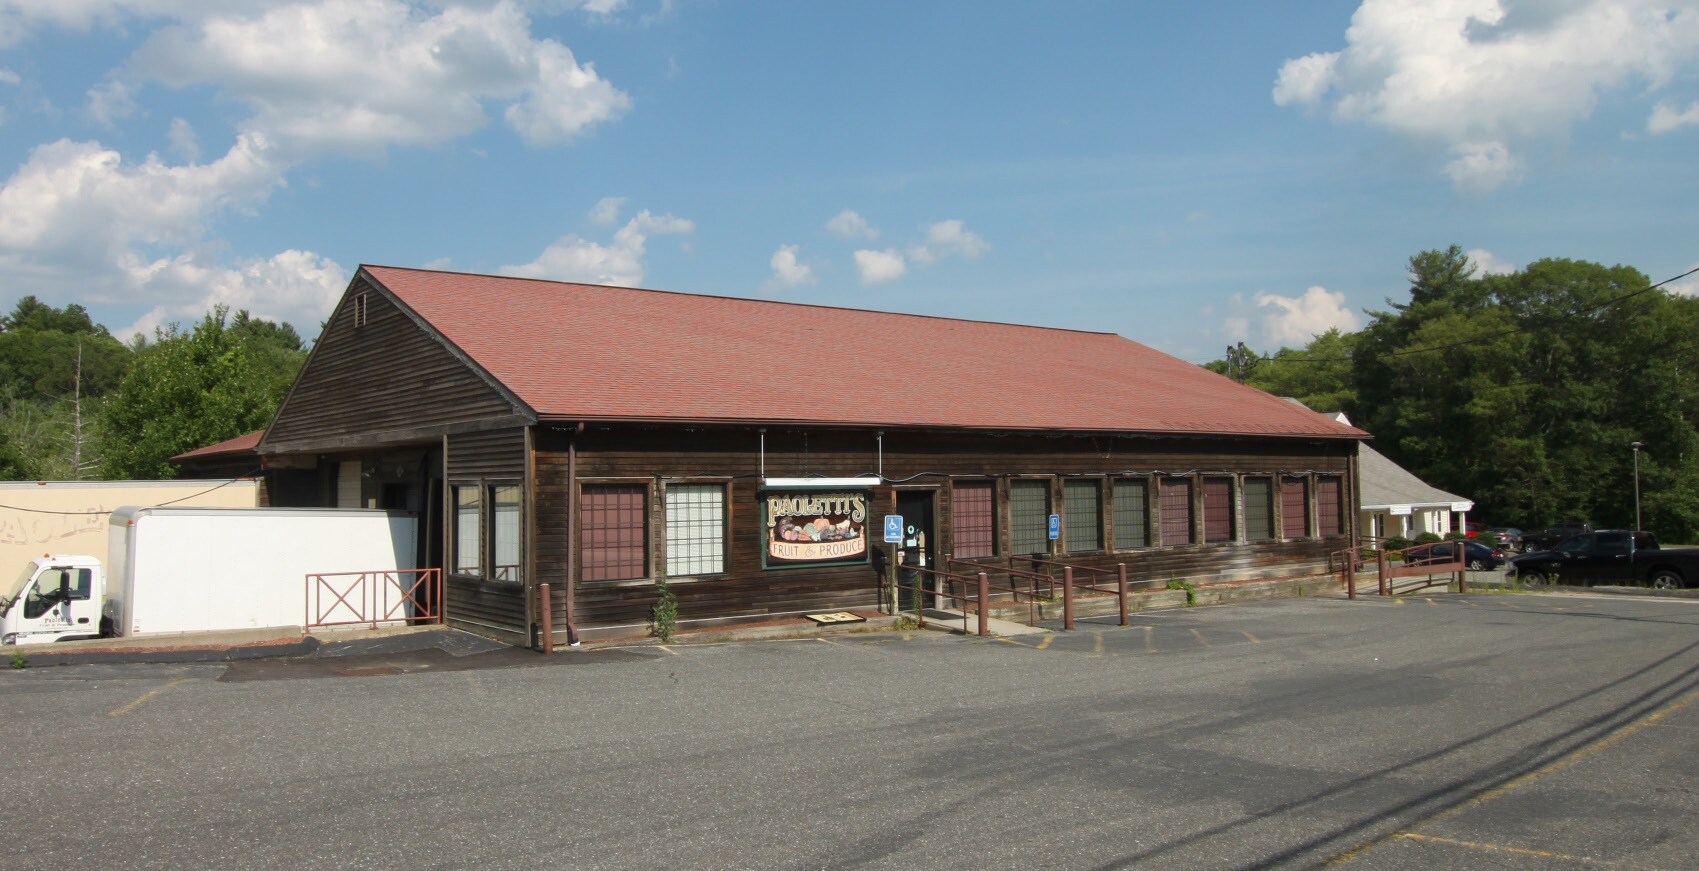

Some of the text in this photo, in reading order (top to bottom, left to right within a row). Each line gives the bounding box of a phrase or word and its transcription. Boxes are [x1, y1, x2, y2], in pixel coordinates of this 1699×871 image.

[767, 493, 866, 527] PAOLETTI'S
[773, 539, 863, 558] FRUIT & PRODUCE
